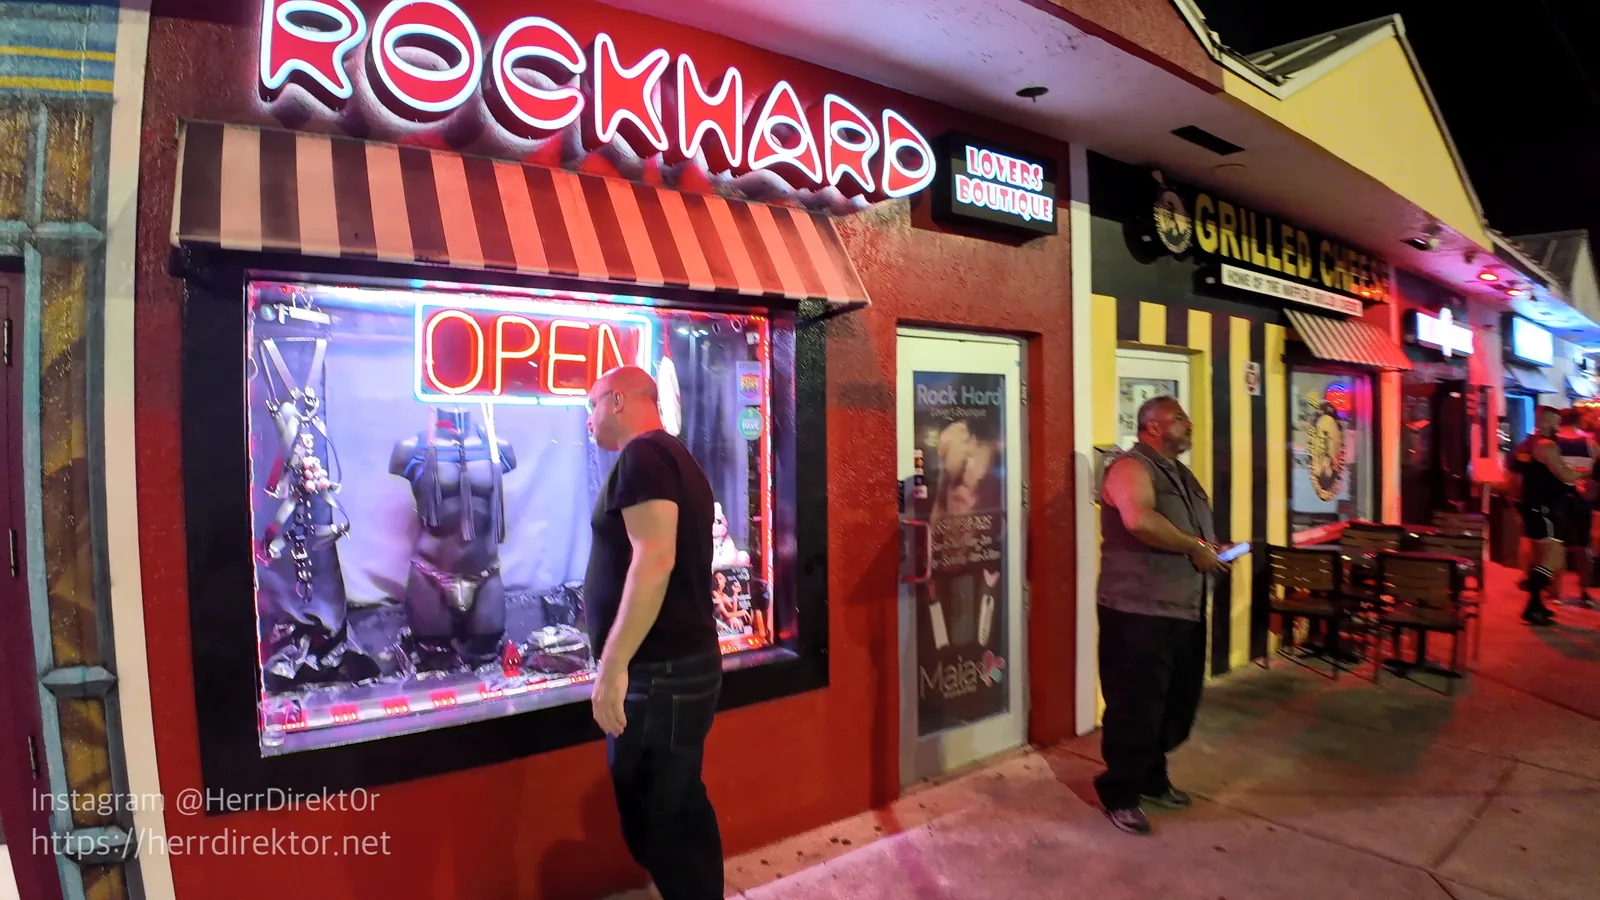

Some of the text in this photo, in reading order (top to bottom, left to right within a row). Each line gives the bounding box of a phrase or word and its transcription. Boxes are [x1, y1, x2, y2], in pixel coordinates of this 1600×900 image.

[966, 145, 1044, 191] LOVERS
[955, 174, 1053, 222] BOUTIQUE
[1194, 193, 1312, 280] GRILLED
[425, 309, 646, 396] OPEN
[917, 384, 1004, 406] Rock Hard
